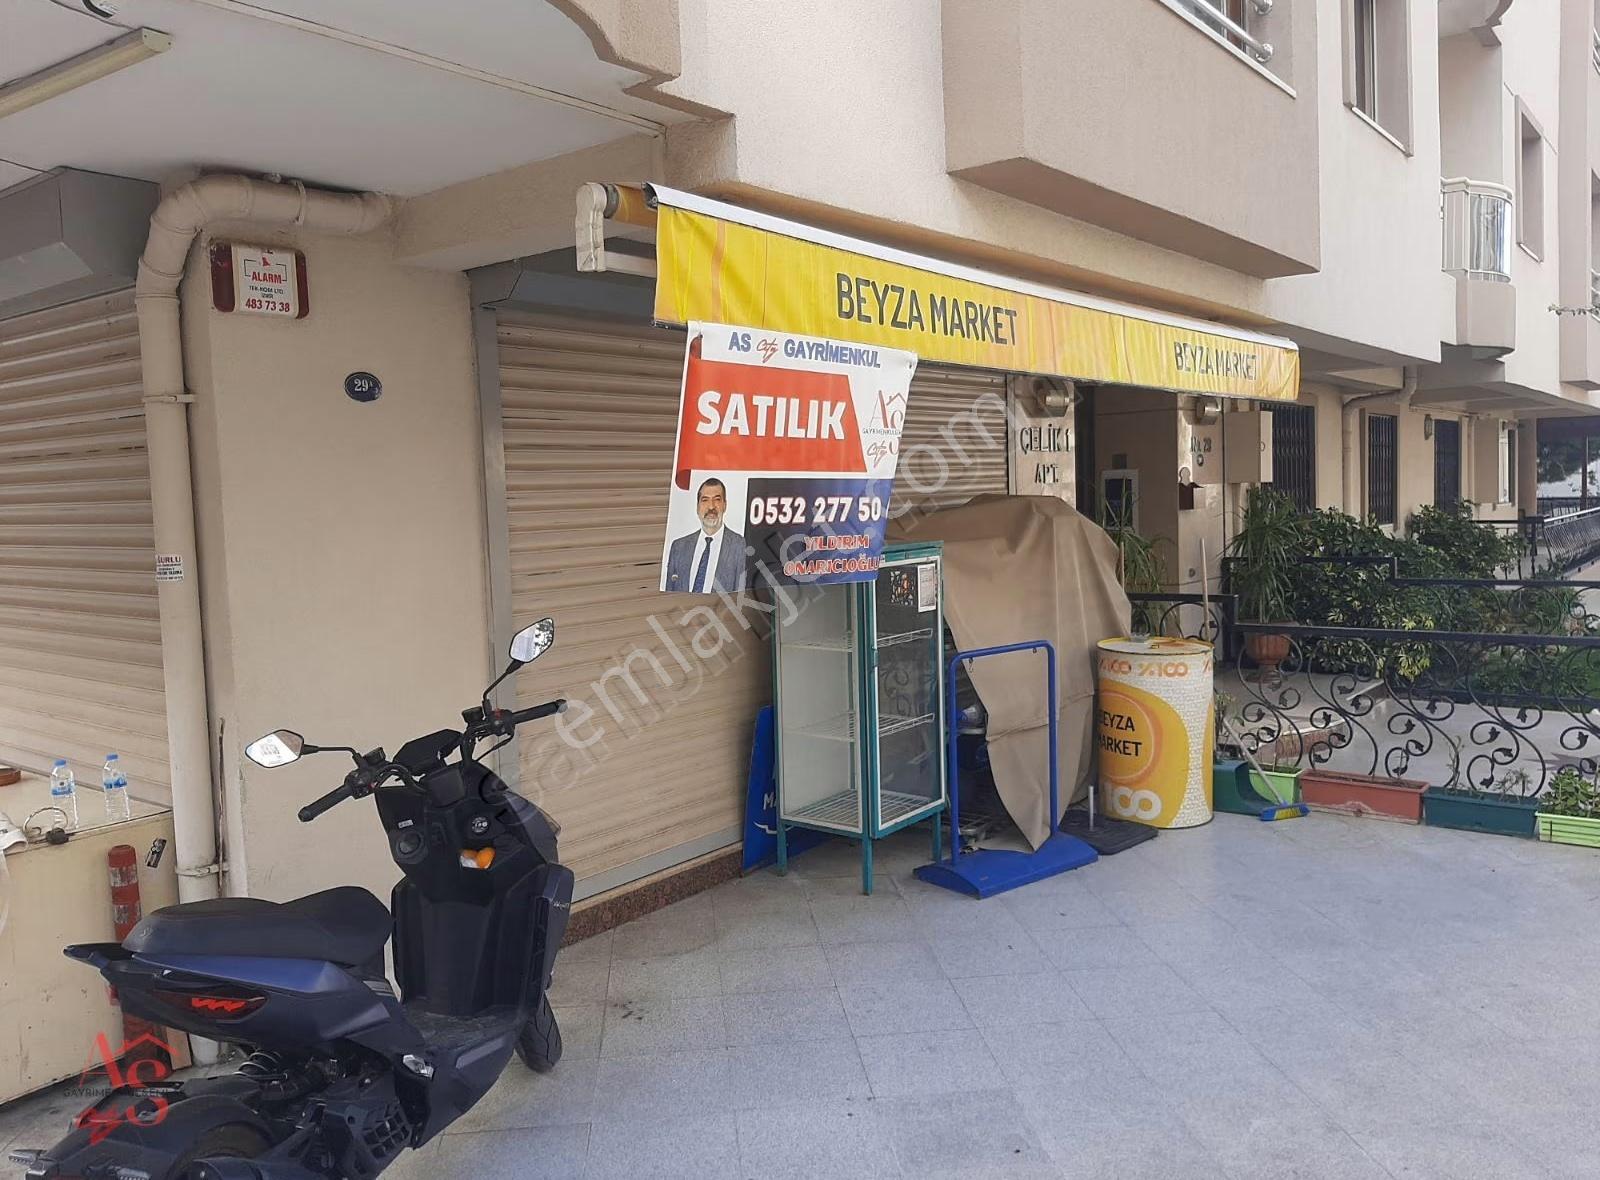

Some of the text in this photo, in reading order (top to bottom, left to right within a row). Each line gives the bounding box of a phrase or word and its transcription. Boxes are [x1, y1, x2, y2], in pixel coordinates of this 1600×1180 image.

[251, 271, 282, 284] ALARM
[245, 298, 291, 313] 483 73 38
[836, 272, 1017, 346] BEYZA MARKET
[728, 332, 751, 351] AS
[784, 339, 881, 368] GAYRİMENKUL
[1173, 341, 1257, 381] BEYZA MARKET
[695, 390, 847, 440] SATILIK
[1020, 424, 1061, 455] ÇELİK
[749, 496, 806, 525] 0532
[813, 496, 853, 523] 277
[858, 496, 882, 522] 50
[804, 534, 870, 551] YILDIRIM
